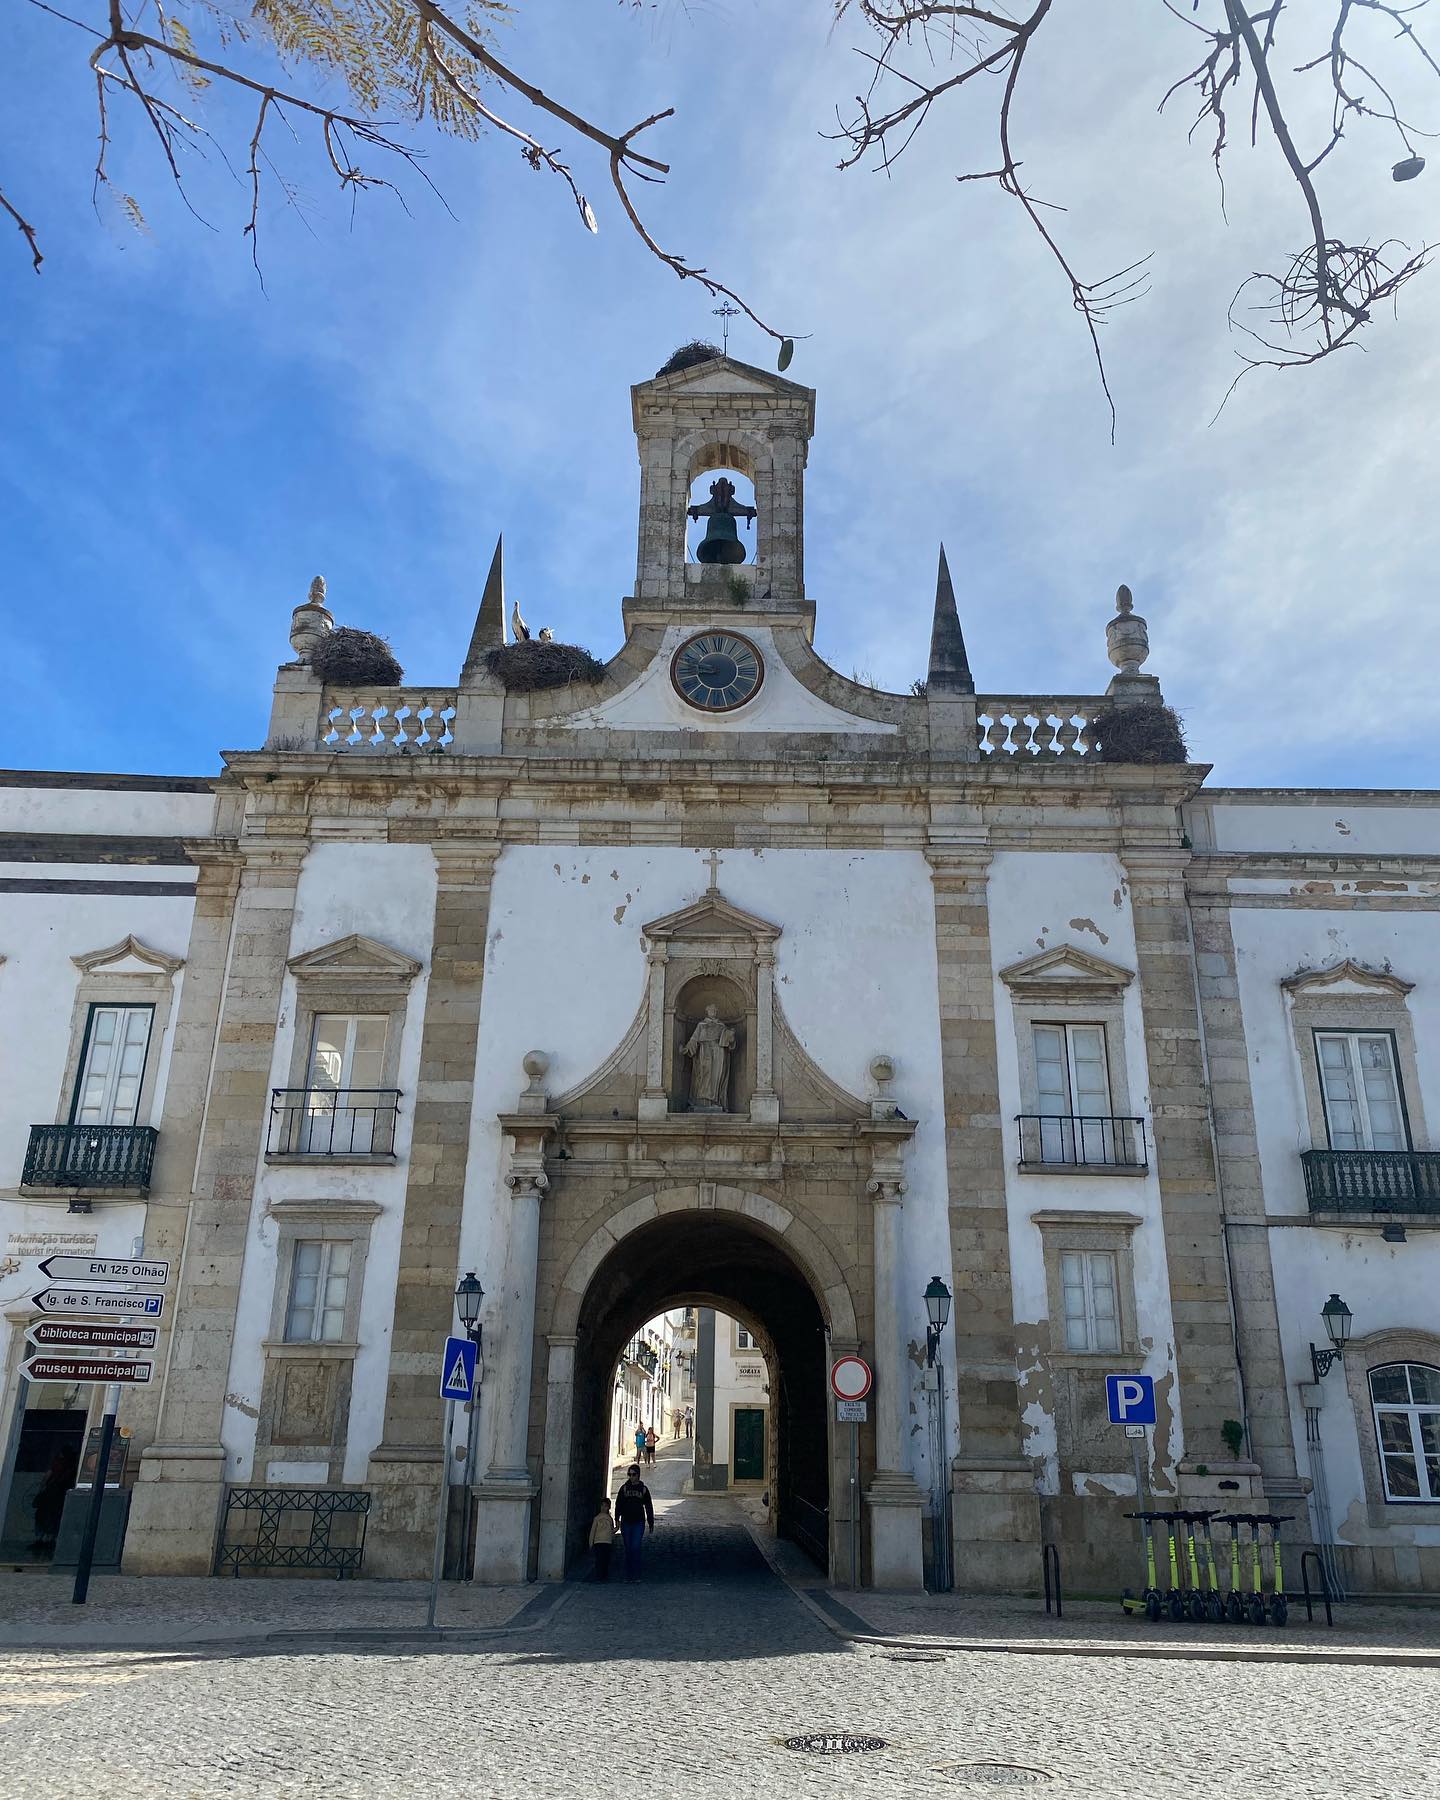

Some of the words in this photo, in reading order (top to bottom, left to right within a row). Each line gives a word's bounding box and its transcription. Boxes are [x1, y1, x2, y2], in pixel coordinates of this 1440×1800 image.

[90, 1263, 107, 1274] EN
[110, 1264, 128, 1275] 125
[131, 1266, 165, 1277] Olhão
[63, 1295, 77, 1305] de
[81, 1296, 91, 1306] S.
[94, 1296, 144, 1309] Francisco
[40, 1327, 90, 1340] biblioteca
[91, 1331, 140, 1343] municipal
[34, 1364, 75, 1374] museu
[78, 1364, 135, 1377] municipal
[1116, 1380, 1144, 1419] P
